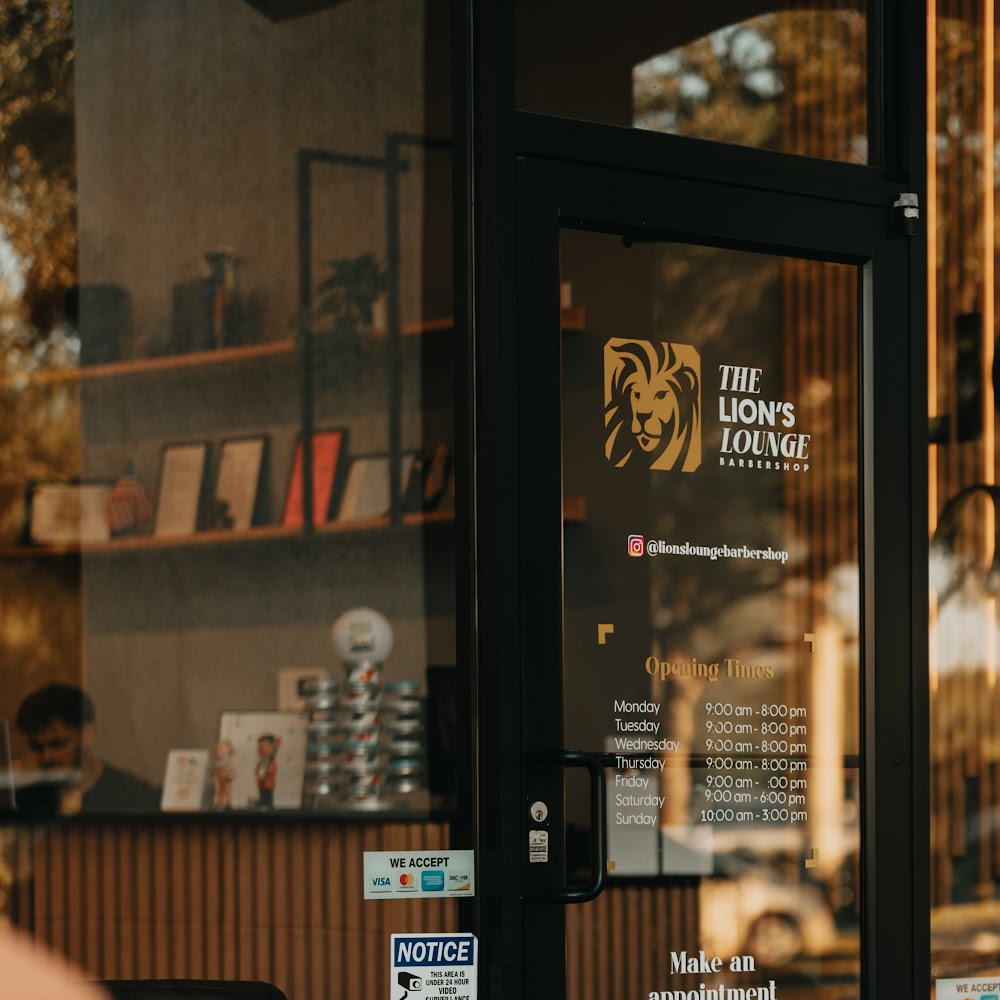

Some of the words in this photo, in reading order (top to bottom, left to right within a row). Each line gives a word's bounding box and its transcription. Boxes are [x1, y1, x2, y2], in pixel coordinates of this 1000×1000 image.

[719, 364, 763, 394] THE
[719, 396, 796, 428] LION'S
[719, 427, 811, 460] LOUNGE
[719, 456, 810, 473] BARBERSHOP
[646, 539, 789, 564] @lionsloungebarbershop
[645, 655, 720, 683] Opening
[724, 658, 775, 679] Times
[614, 700, 660, 715] Monday
[705, 702, 733, 716] 9:00
[735, 706, 753, 717] am
[761, 704, 788, 717] 8:00
[789, 707, 807, 719] pm
[615, 718, 660, 734] Tuesday
[706, 720, 733, 734] 9:00
[735, 723, 753, 734] am
[761, 722, 788, 735] 8:00
[790, 725, 807, 737] pm
[615, 738, 680, 753] Wednesday
[706, 739, 733, 752] 9:00
[735, 742, 753, 752] am
[761, 740, 788, 753] 8:00
[790, 743, 807, 755] pm
[615, 756, 665, 772] Thursday
[706, 757, 733, 770] 9:00
[735, 760, 753, 770] am
[761, 758, 788, 771] 8:00
[790, 761, 807, 773] pm
[615, 775, 649, 789] Friday
[706, 775, 733, 788] 9:00
[735, 778, 753, 788] am
[790, 779, 807, 791] pm
[615, 794, 665, 808] Saturday
[705, 789, 732, 802] 9:00
[734, 792, 752, 802] am
[760, 791, 787, 803] 6:00
[788, 794, 806, 806] pm
[616, 812, 657, 827] Sunday
[700, 809, 734, 822] 10:00
[736, 811, 754, 821] am
[762, 808, 788, 821] 3:00
[790, 811, 808, 823] pm
[390, 858, 406, 868] WE
[409, 857, 450, 868] ACCEPT
[372, 877, 391, 886] VISA
[397, 941, 471, 963] NOTICE
[669, 950, 723, 975] Make
[729, 953, 756, 973] an
[438, 987, 457, 995] VIDEO
[956, 984, 969, 993] WE
